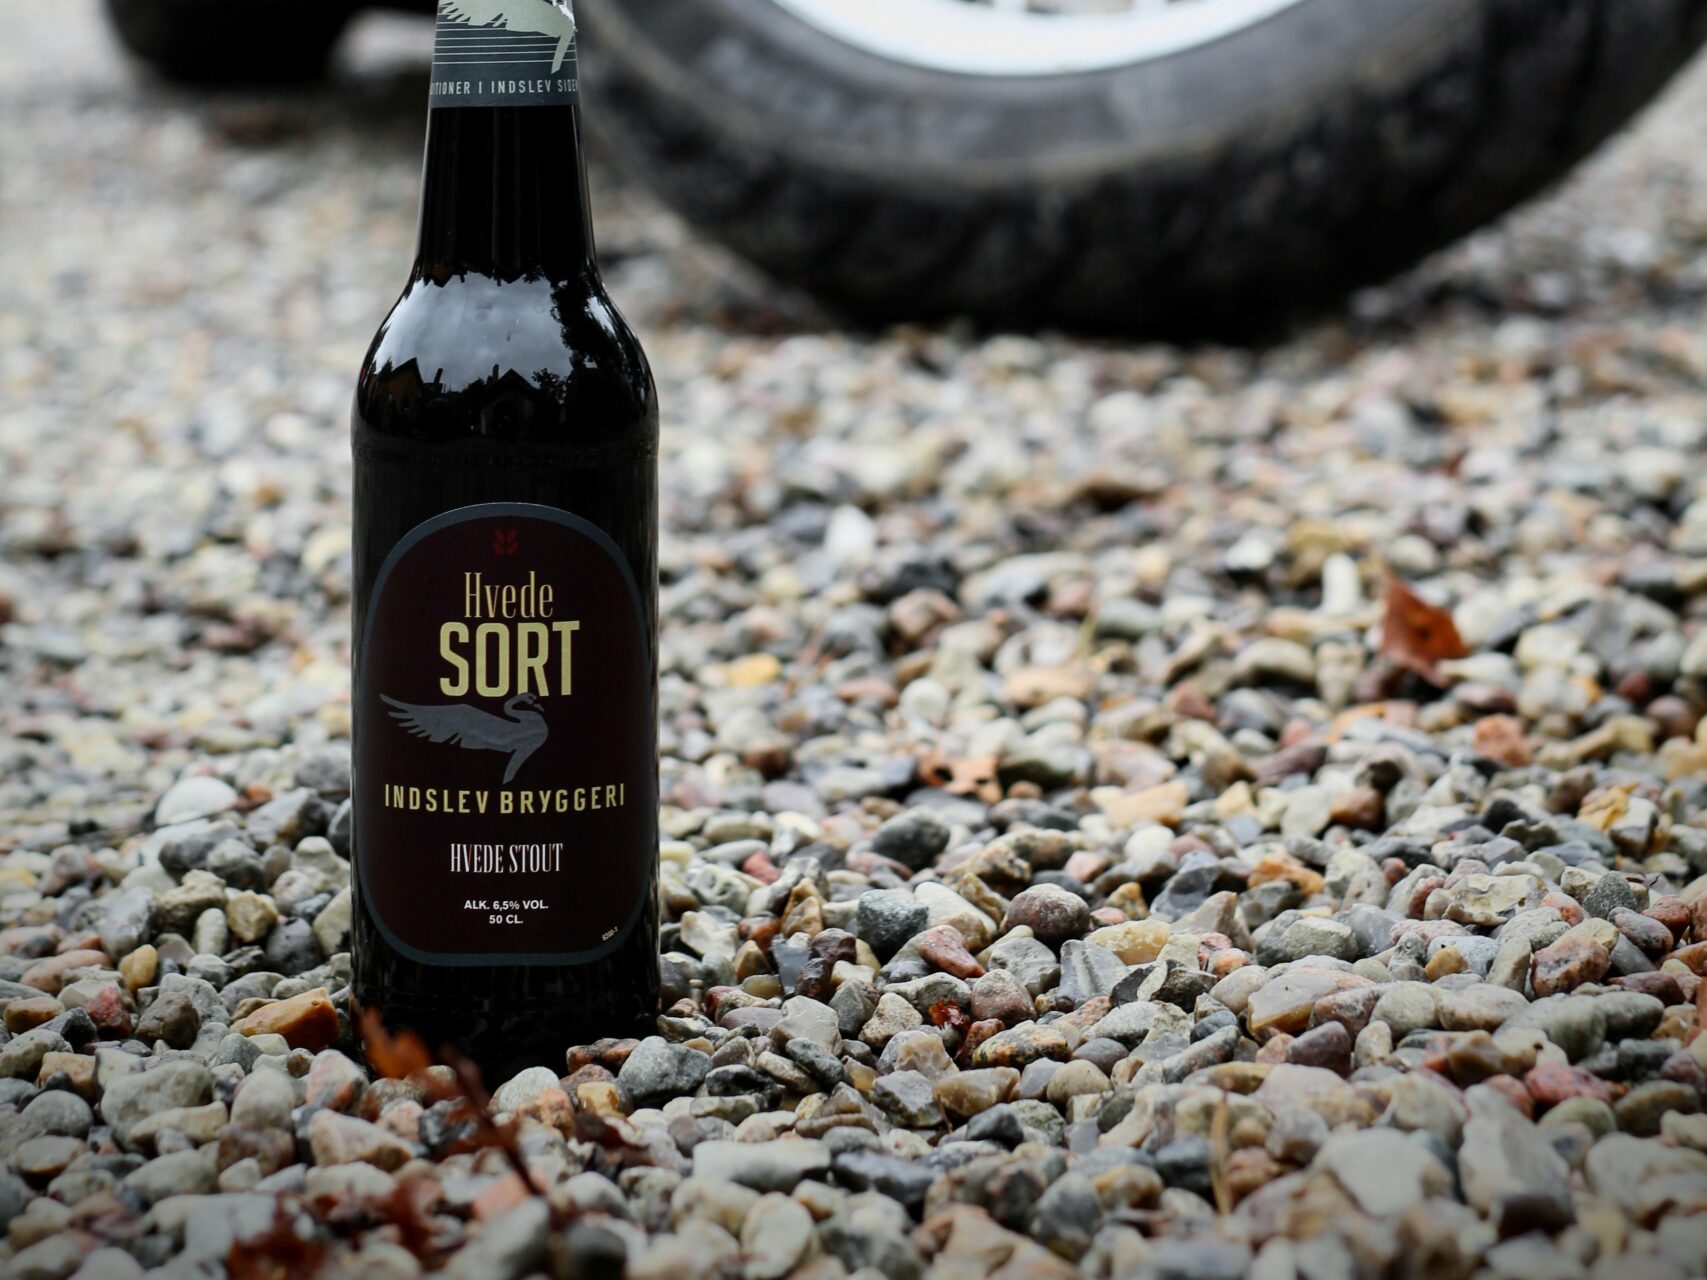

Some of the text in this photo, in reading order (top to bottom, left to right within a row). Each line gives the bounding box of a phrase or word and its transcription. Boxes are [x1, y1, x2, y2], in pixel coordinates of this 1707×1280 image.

[491, 79, 552, 94] INDSLEV
[464, 570, 554, 619] Hvede
[439, 620, 581, 698] SORT
[384, 783, 625, 814] INDSLEV BRYGGERI
[450, 842, 564, 874] HVEDE STOUT
[463, 898, 549, 912] ALK. 6,5% VOL.
[488, 914, 524, 925] 50 CL.
